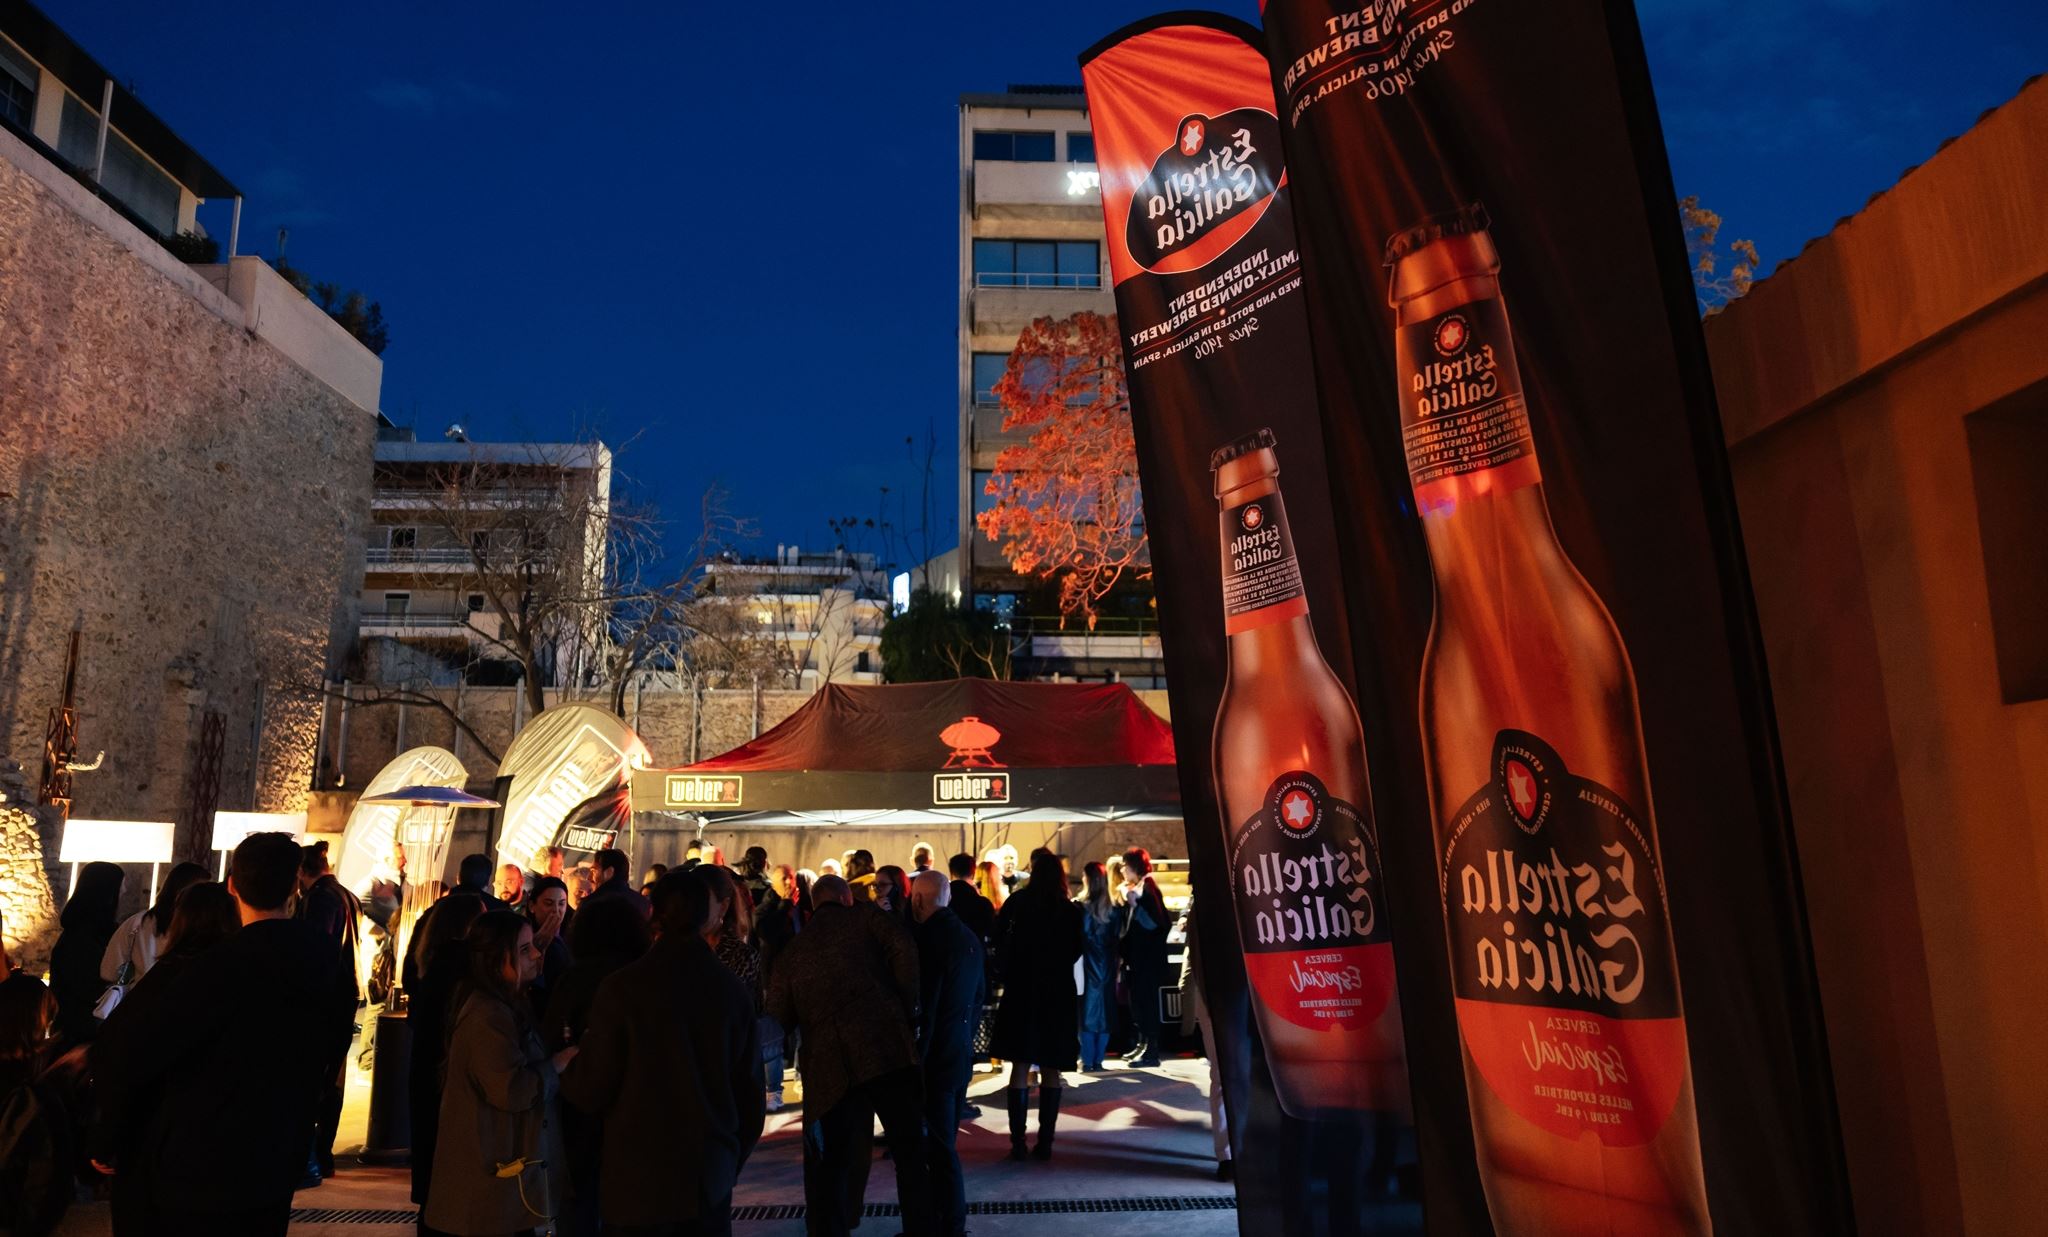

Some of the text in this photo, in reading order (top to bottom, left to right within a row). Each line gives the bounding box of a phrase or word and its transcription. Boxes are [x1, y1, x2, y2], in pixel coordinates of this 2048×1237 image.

[671, 778, 723, 802] weber
[940, 776, 991, 800] weber
[509, 761, 589, 860] weber
[566, 828, 609, 850] weber
